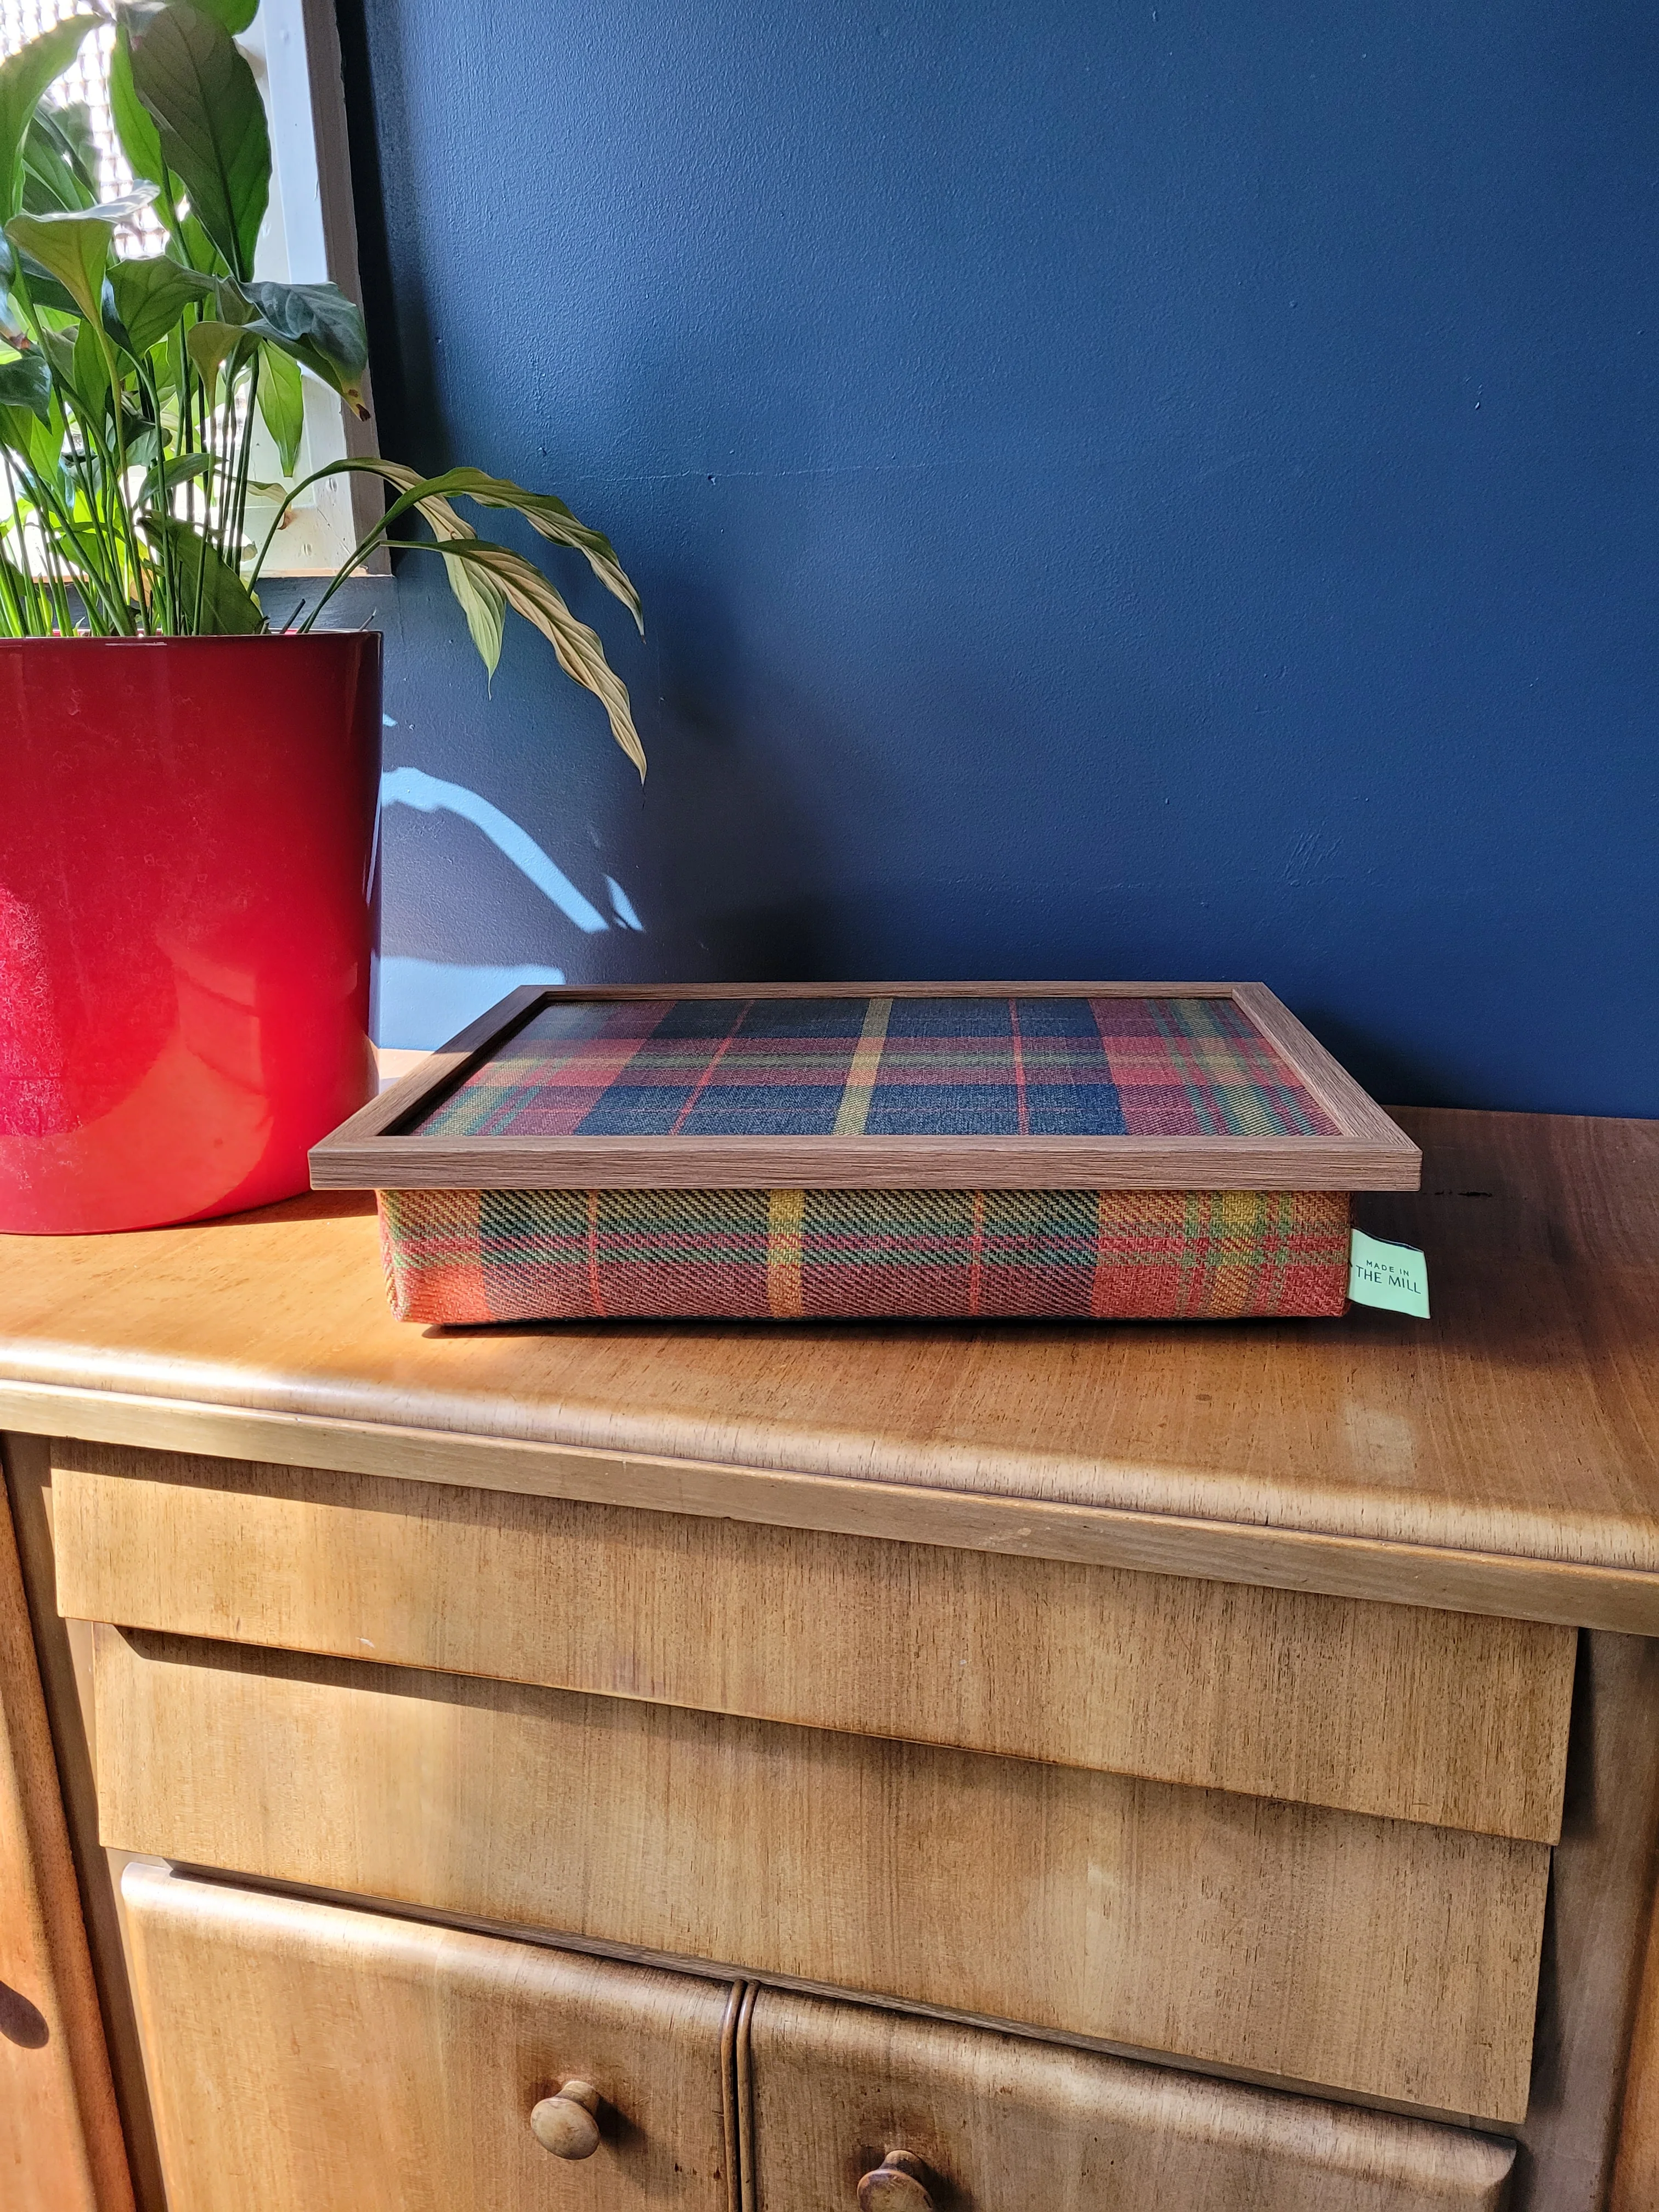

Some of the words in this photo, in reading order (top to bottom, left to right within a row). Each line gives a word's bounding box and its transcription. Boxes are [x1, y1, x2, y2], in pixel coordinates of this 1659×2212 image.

[1356, 1265, 1383, 1284] THE
[1389, 1275, 1421, 1295] MILL
[1366, 1260, 1395, 1273] MADE
[1400, 1268, 1409, 1277] IN
